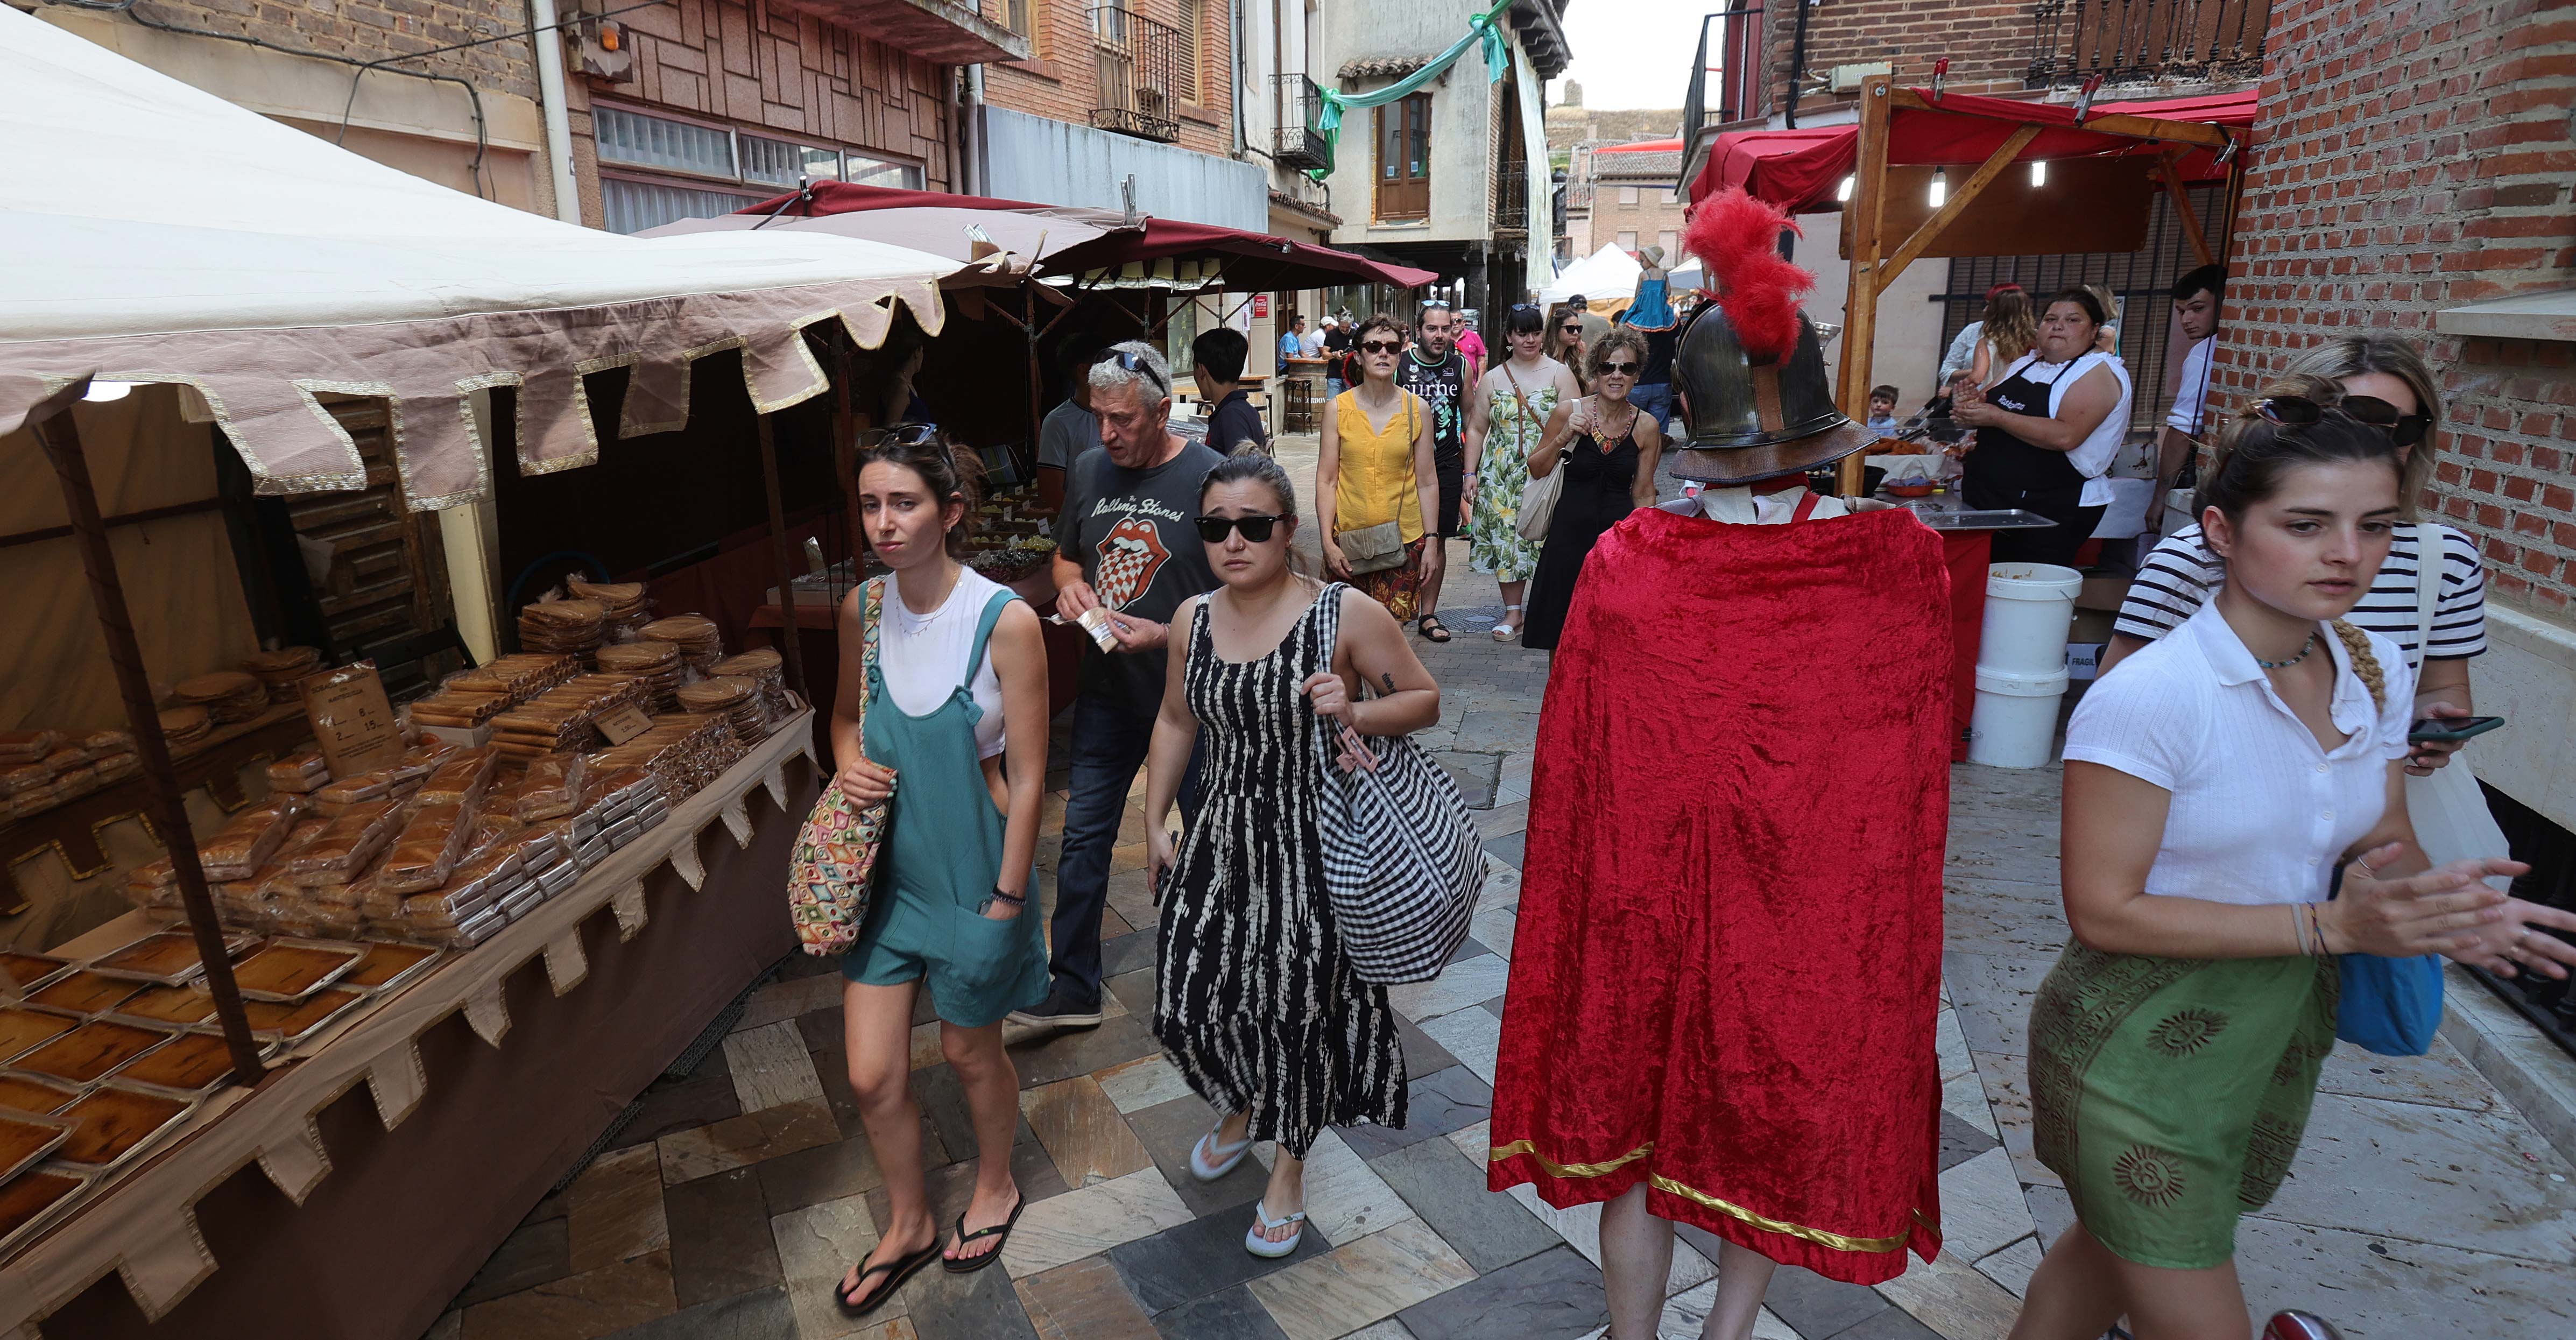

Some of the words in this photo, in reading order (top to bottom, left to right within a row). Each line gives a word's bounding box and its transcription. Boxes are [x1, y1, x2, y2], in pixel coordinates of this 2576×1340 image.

[1091, 497, 1138, 517] Rolling
[1137, 498, 1184, 521] Stones
[2072, 658, 2095, 666] FRAGIL
[336, 732, 342, 742] 2
[364, 720, 376, 731] 15
